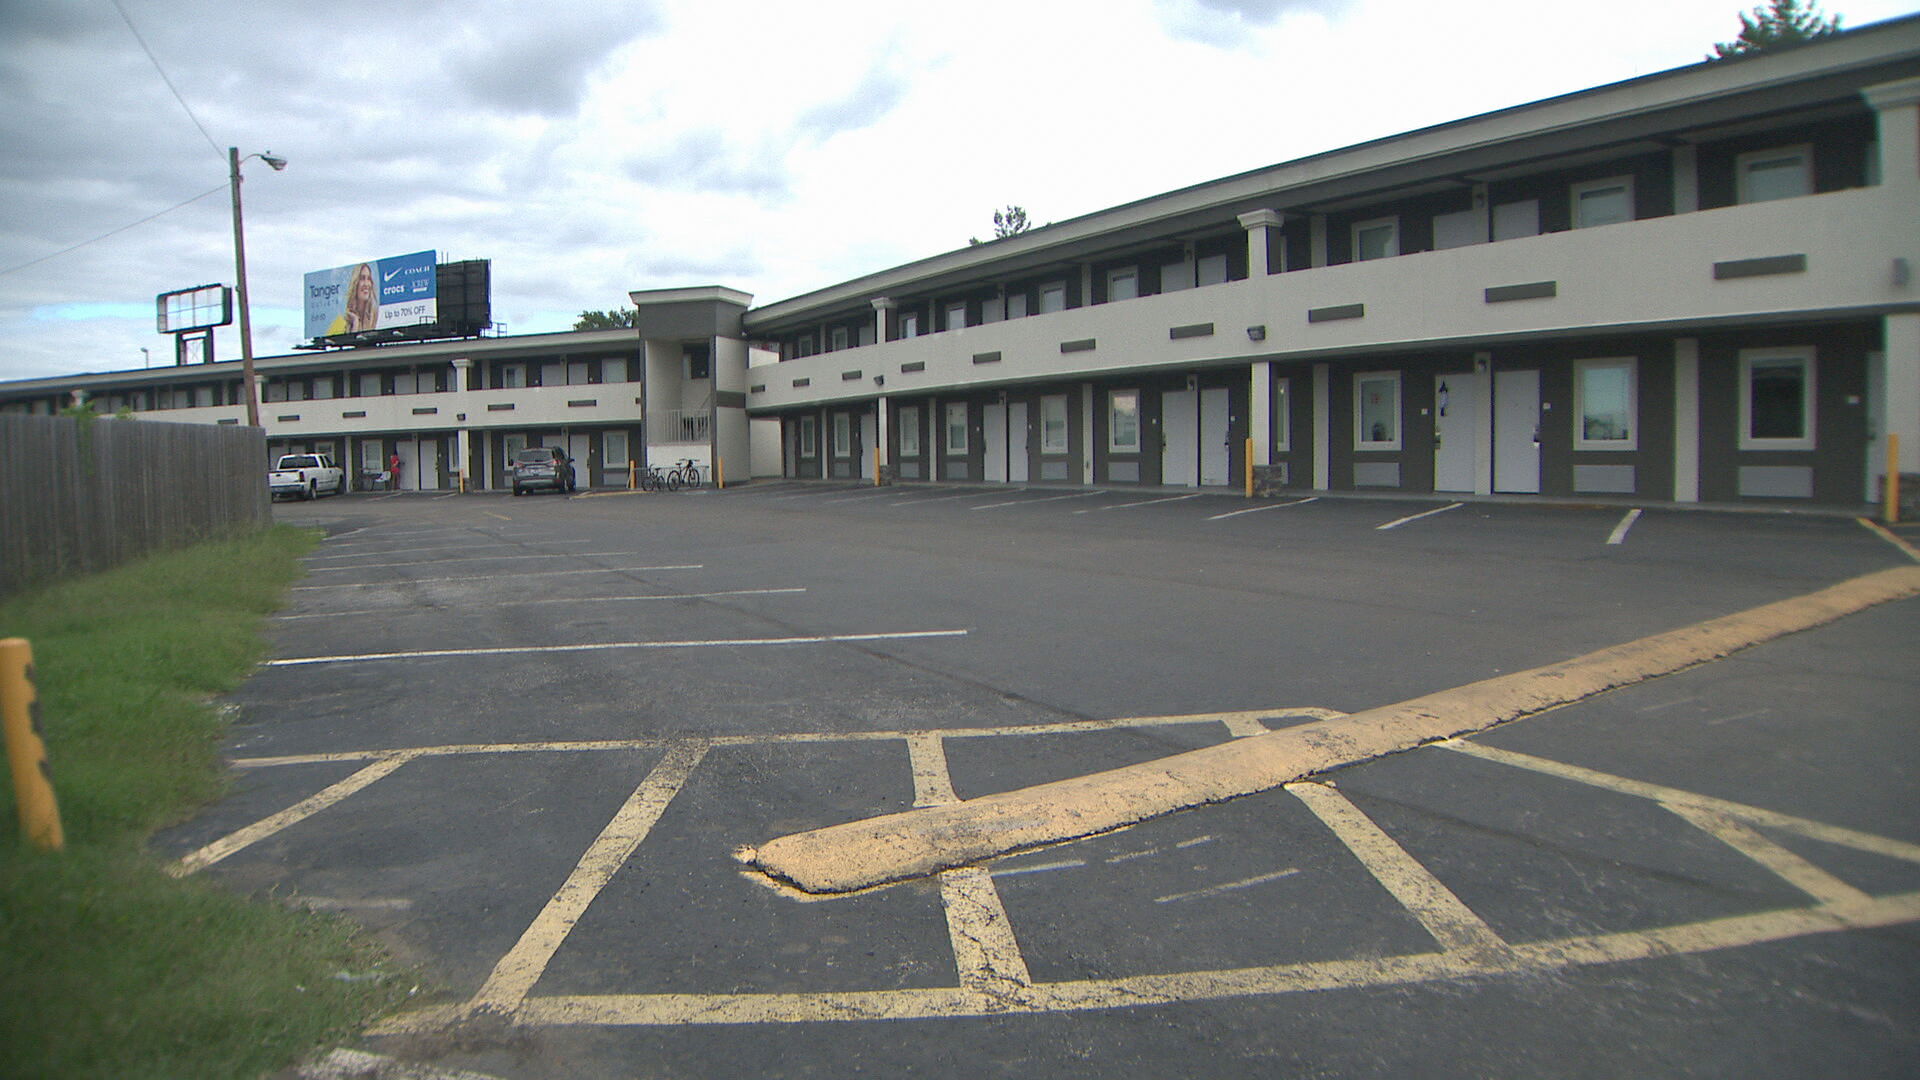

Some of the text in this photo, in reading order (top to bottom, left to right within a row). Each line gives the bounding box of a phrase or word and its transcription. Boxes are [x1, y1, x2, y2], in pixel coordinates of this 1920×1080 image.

[310, 284, 340, 299] Tanger
[383, 285, 405, 295] crocs
[384, 311, 393, 320] Up
[413, 305, 426, 315] OFF
